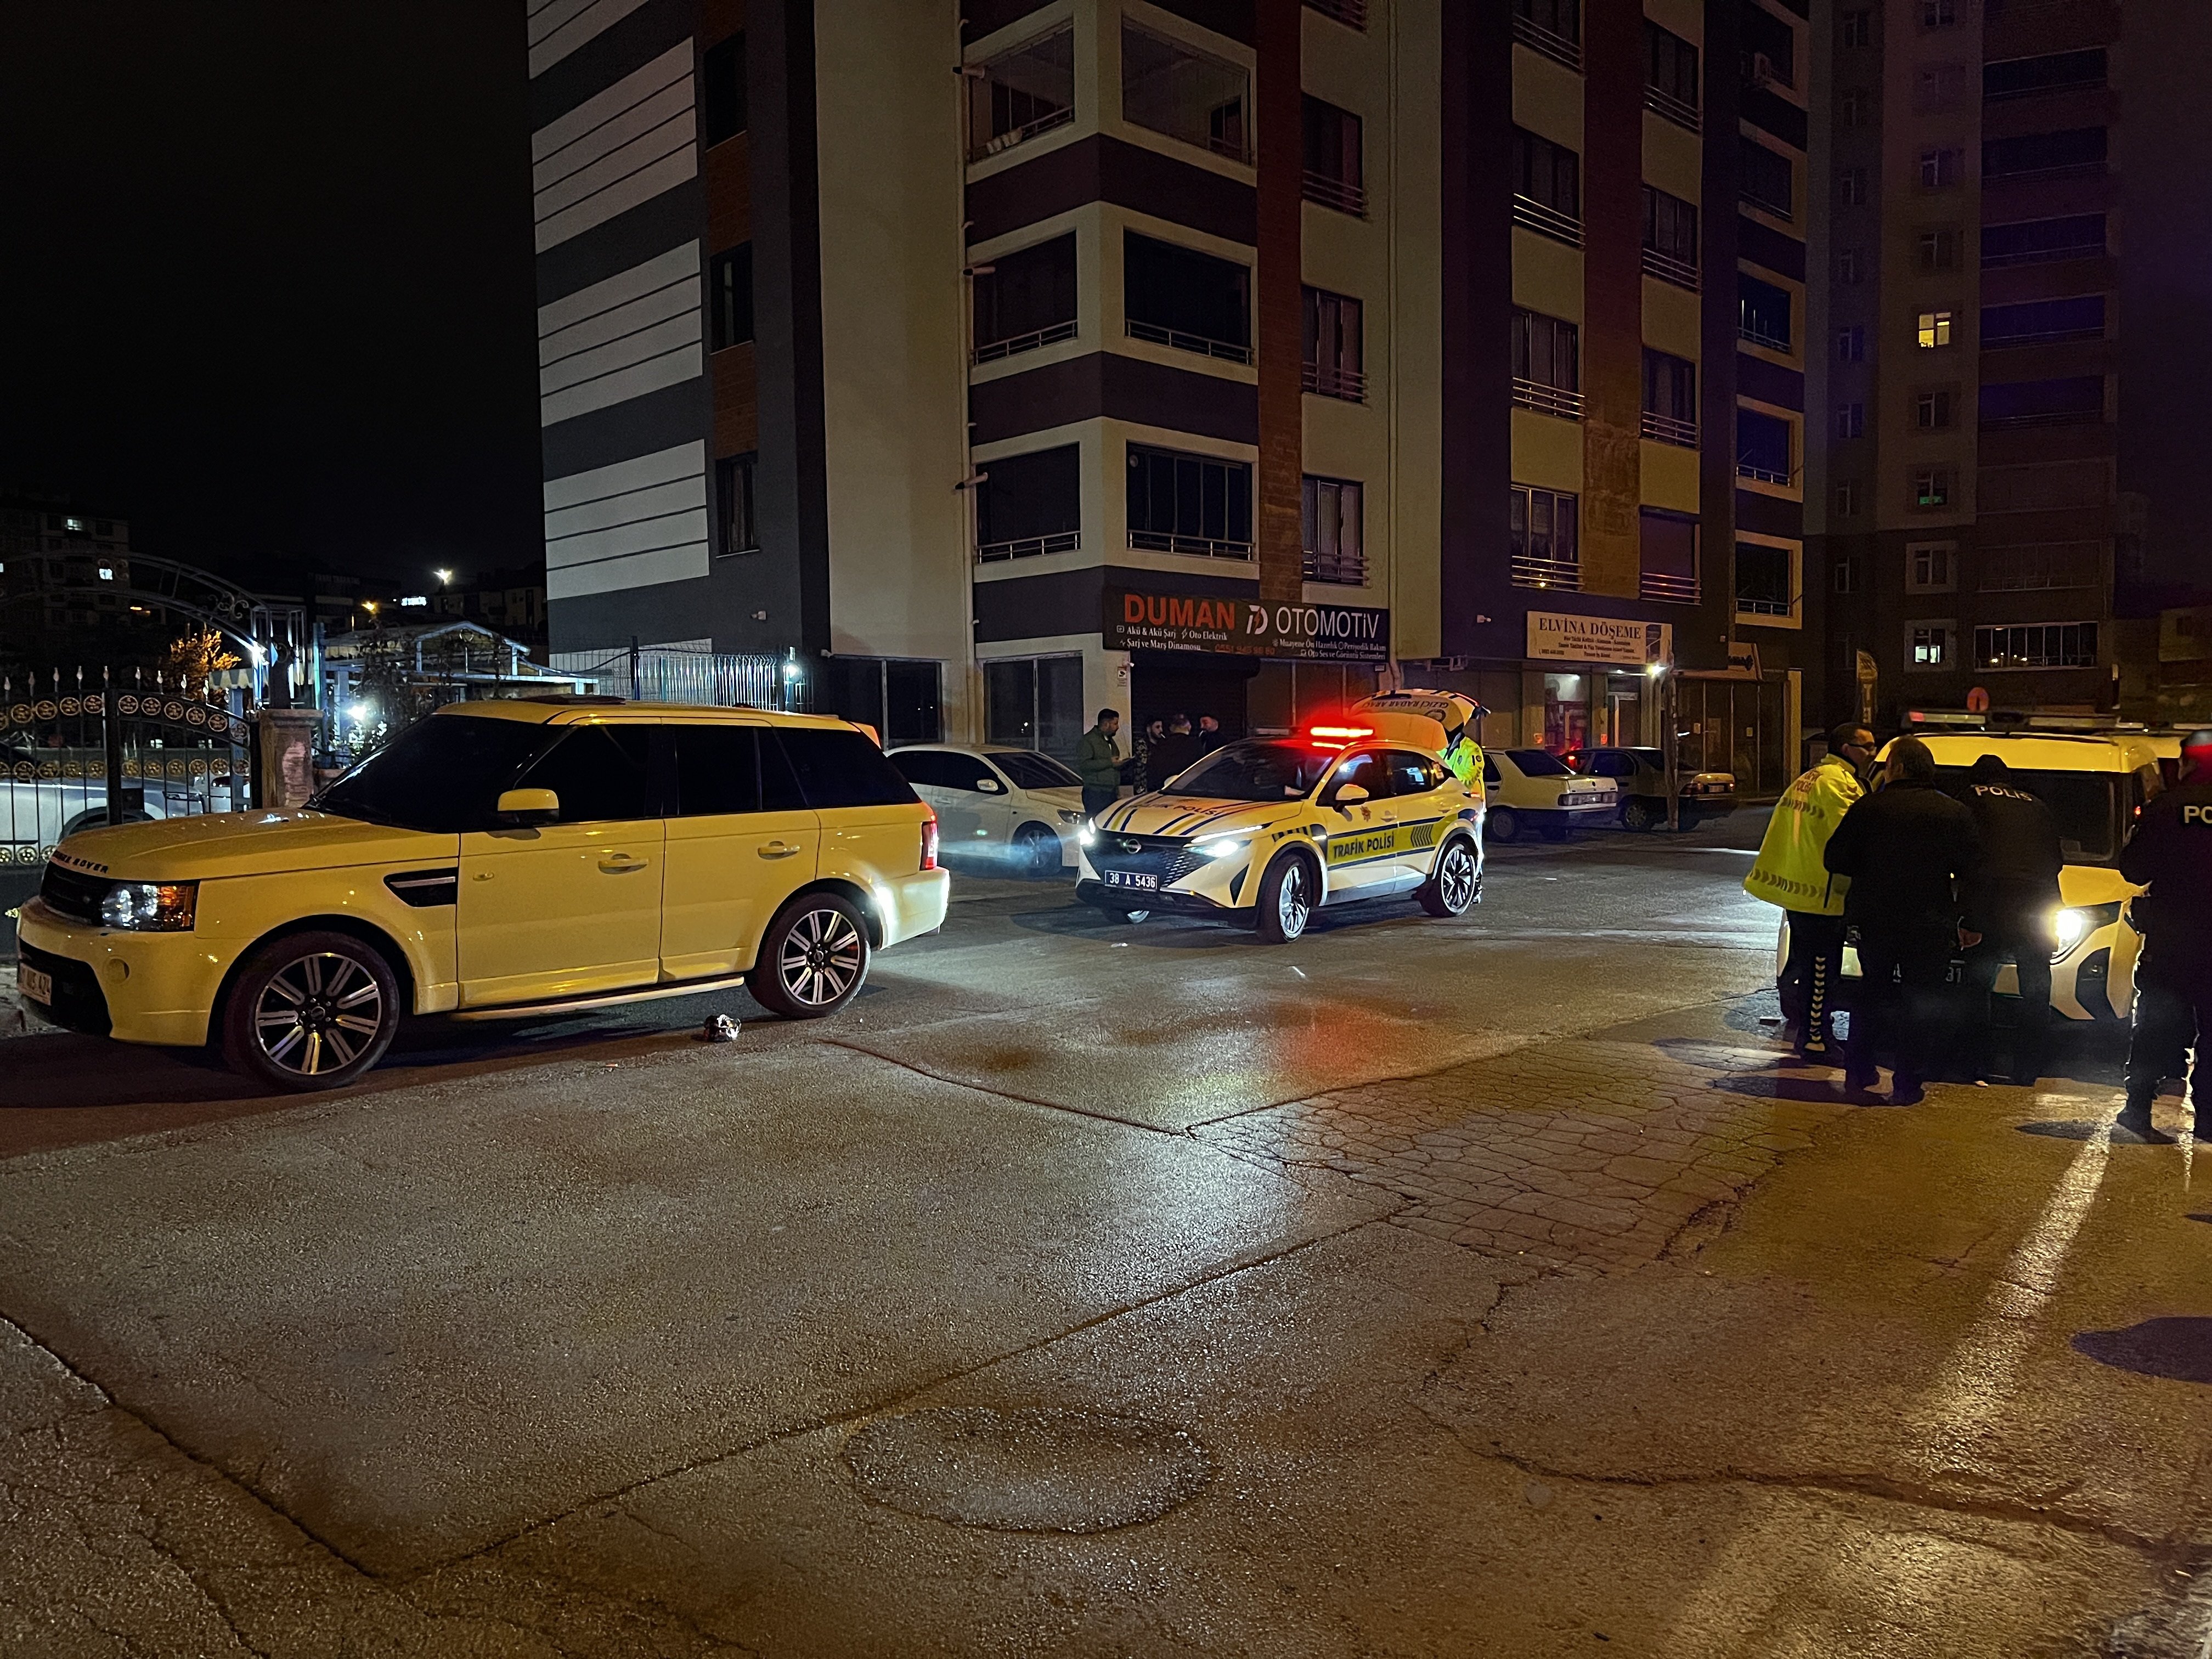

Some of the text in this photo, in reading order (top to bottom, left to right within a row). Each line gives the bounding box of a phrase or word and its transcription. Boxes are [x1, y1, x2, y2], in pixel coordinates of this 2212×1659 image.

[1125, 594, 1235, 630] DUMAN
[1127, 626, 1176, 639] Akü & Akü Şarj
[1189, 630, 1228, 641] Oto Elektrik
[1539, 618, 1641, 640] ELVİNA DÖŞEME
[1127, 638, 1140, 648] Şarj
[1150, 640, 1167, 650] Marş
[1169, 641, 1201, 651] Dinamosu
[1280, 638, 1305, 649] Muayene
[1333, 832, 1394, 859] TRAFİK POLİSİ
[1109, 872, 1155, 888] 38 A 5436
